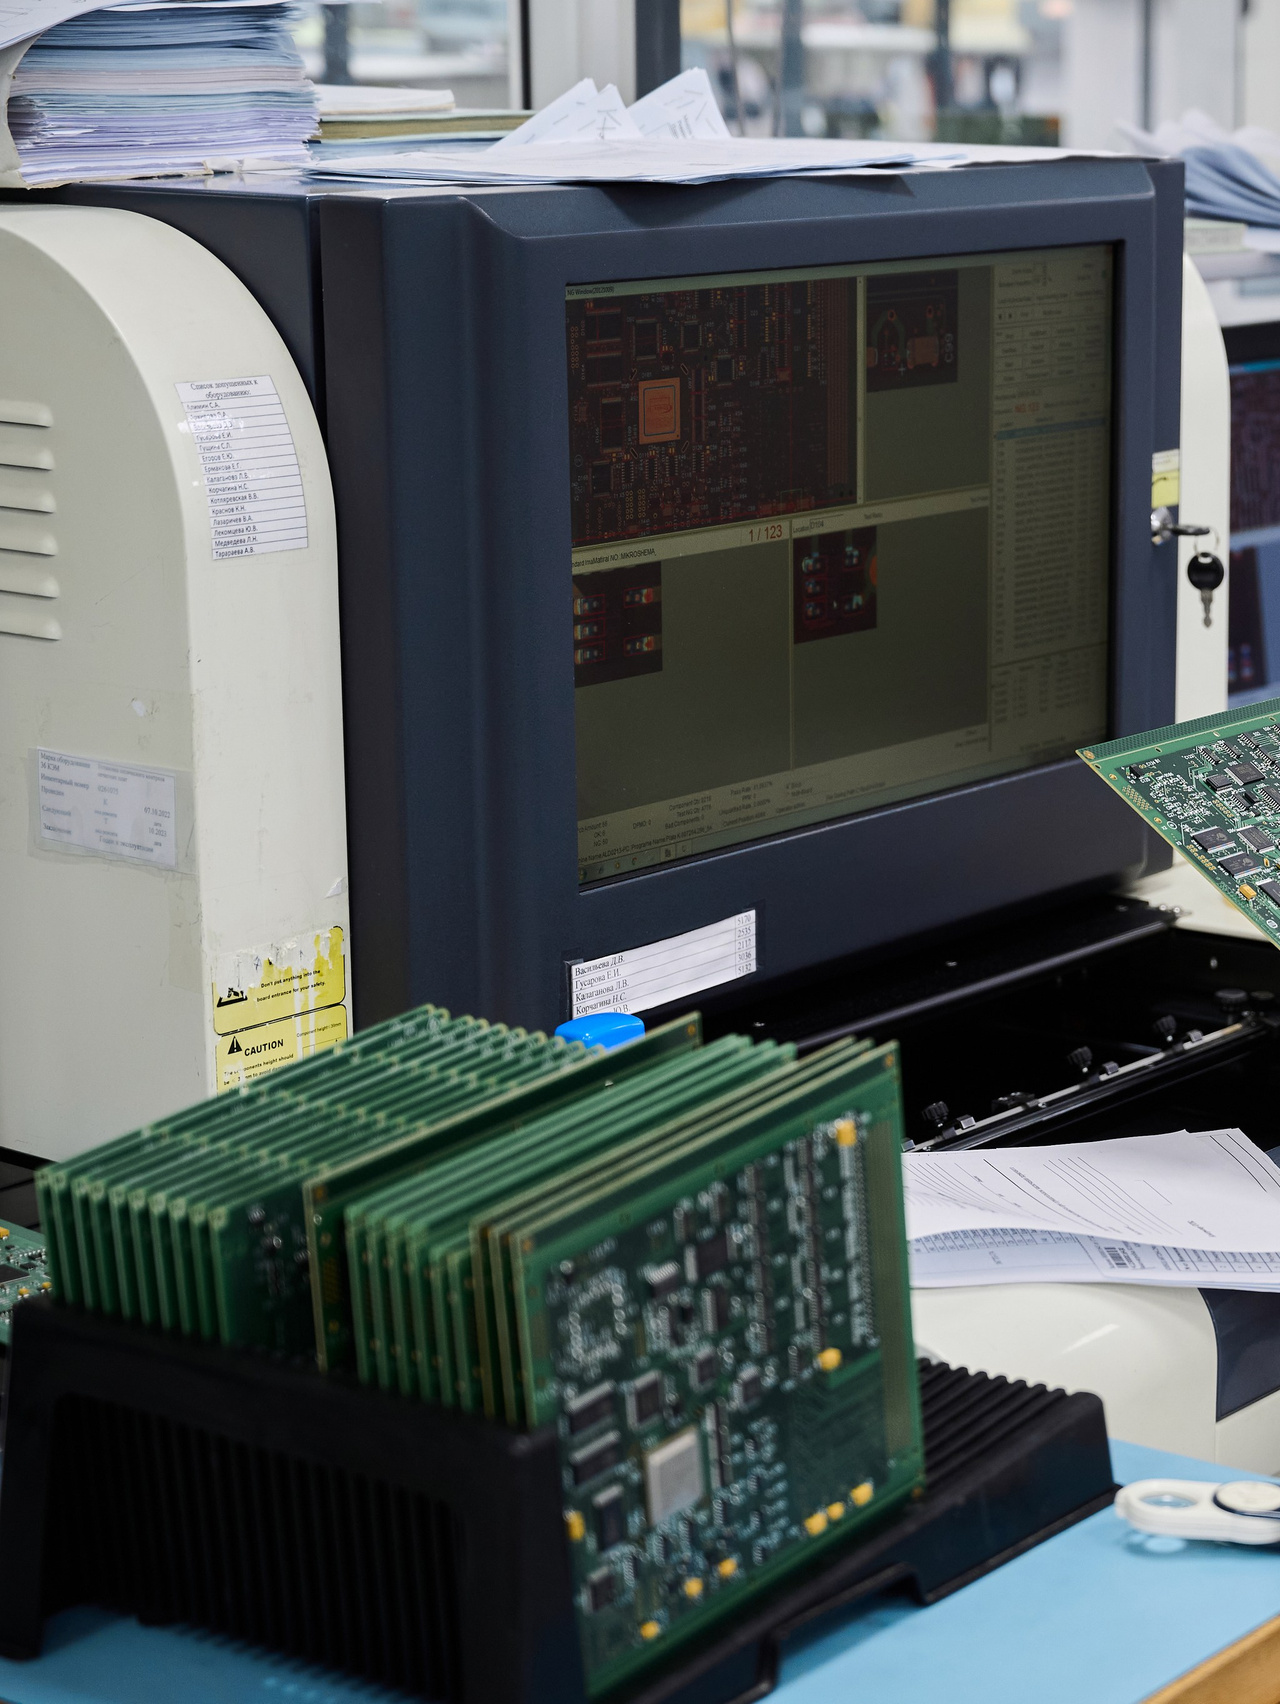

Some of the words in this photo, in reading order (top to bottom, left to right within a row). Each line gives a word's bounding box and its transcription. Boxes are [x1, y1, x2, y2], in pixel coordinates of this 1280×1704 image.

[749, 528, 754, 542] 1
[764, 524, 783, 539] 123
[575, 960, 610, 977] Васильева
[282, 973, 302, 983] anything
[575, 974, 606, 990] Гусарова
[606, 968, 622, 979] Е.И.
[256, 993, 271, 1002] board
[271, 989, 292, 998] entrance
[299, 984, 310, 993] your
[575, 985, 614, 1002] Калаганова
[615, 979, 630, 990] Л.В.
[576, 999, 611, 1015] Корчагина
[612, 992, 627, 1003] Н.С.
[244, 1038, 284, 1057] CAUTION
[262, 1057, 278, 1067] height
[278, 1053, 294, 1062] should
